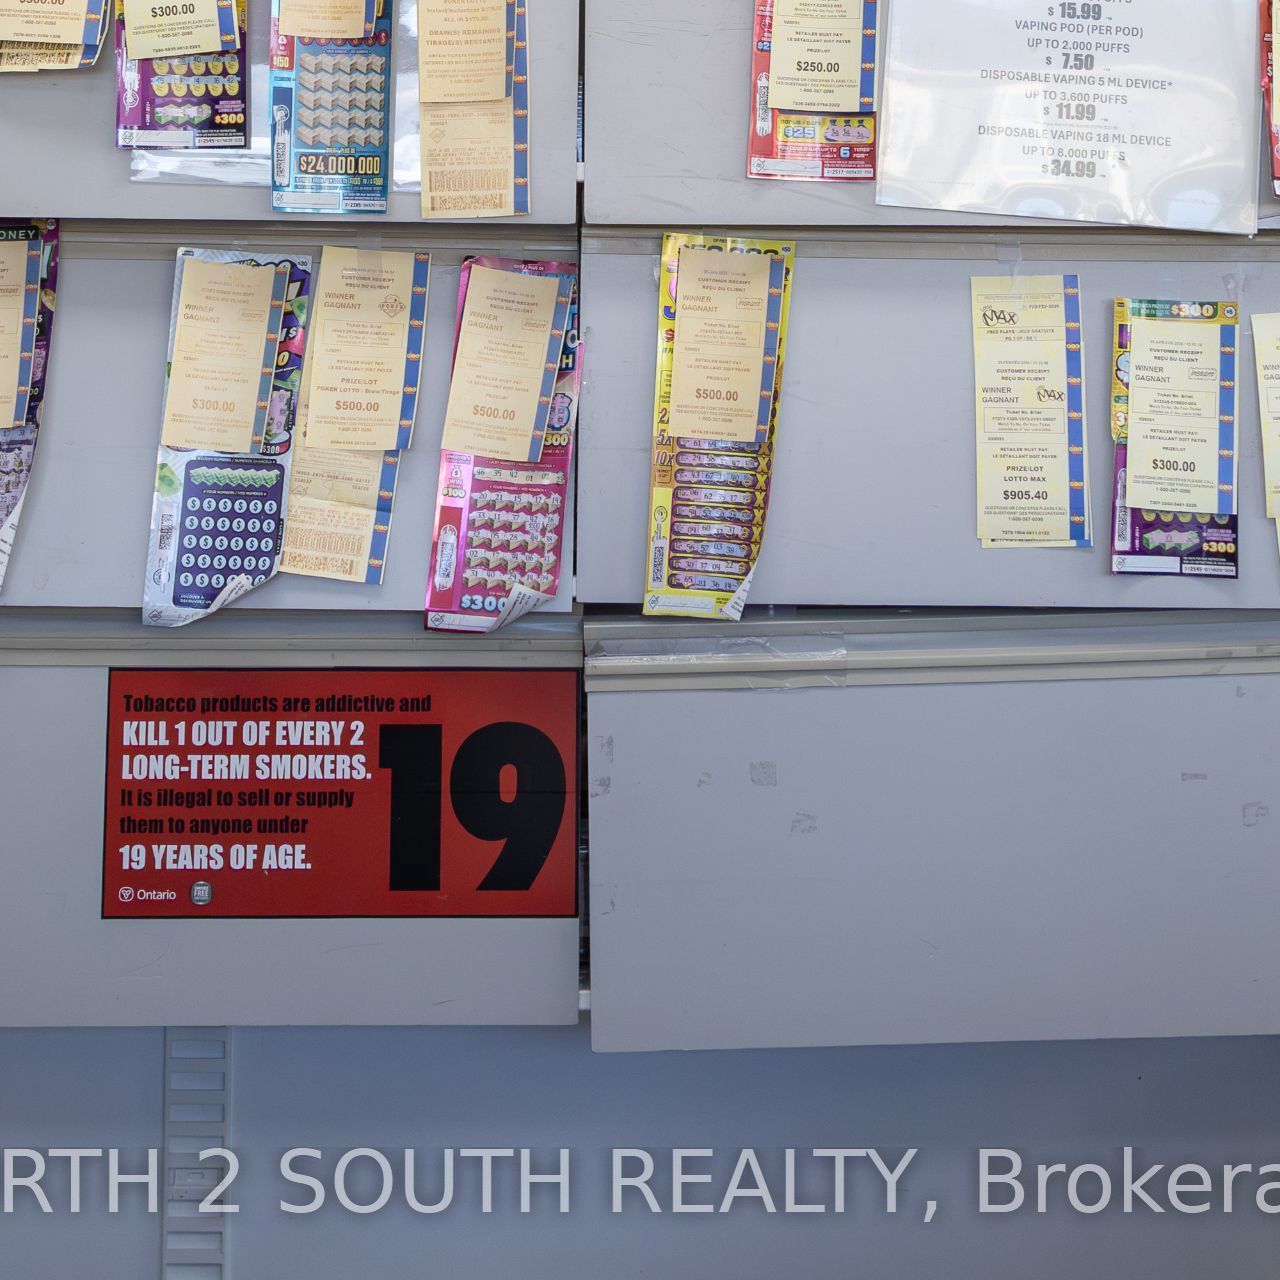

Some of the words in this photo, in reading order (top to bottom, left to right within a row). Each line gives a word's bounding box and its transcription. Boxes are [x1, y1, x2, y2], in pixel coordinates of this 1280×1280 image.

[1048, 6, 1054, 16] $
[1059, 2, 1102, 20] 15.99
[1015, 20, 1057, 32] VAPING
[1060, 23, 1084, 34] POD
[1087, 25, 1113, 36] (PER
[1115, 26, 1143, 38] POD)
[796, 62, 840, 73] $250.00
[1046, 56, 1052, 66] $
[1062, 53, 1094, 70] 7.50
[980, 70, 1051, 83] DISPOSABLE
[1053, 74, 1096, 85] VAPING
[1098, 77, 1104, 86] 5
[1108, 78, 1123, 87] ML
[1043, 107, 1050, 115] $
[1056, 103, 1096, 121] 11.99
[1051, 159, 1096, 178] 34.99
[694, 388, 739, 402] $500.00
[191, 399, 236, 412] $300.00
[334, 400, 379, 413] $500.00
[1003, 490, 1048, 501] $905.40
[123, 695, 196, 712] Tobacco
[201, 695, 278, 714] products
[282, 699, 310, 712] are
[315, 695, 394, 712] addictive
[399, 695, 431, 712] and
[123, 721, 169, 746] KILL
[175, 721, 185, 745] 1
[192, 721, 236, 746] OUT
[243, 721, 270, 745] OF
[276, 721, 345, 745] EVERY
[350, 721, 364, 745] 2
[122, 755, 249, 780] LONG-TERM
[256, 755, 372, 779] SMOKERS.
[121, 790, 133, 806] It
[138, 789, 152, 806] is
[157, 789, 212, 809] illegal
[217, 791, 233, 806] to
[237, 789, 269, 806] sell
[274, 793, 291, 806] or
[296, 789, 354, 808] supply
[378, 722, 566, 891] 19
[120, 817, 164, 834] them
[168, 818, 185, 834] to
[189, 820, 252, 835] anyone
[257, 817, 308, 833] under
[119, 845, 145, 869] 19
[152, 845, 223, 869] YEARS
[230, 845, 257, 869] OF
[262, 845, 311, 869] AGE.
[137, 890, 176, 900] Ontario
